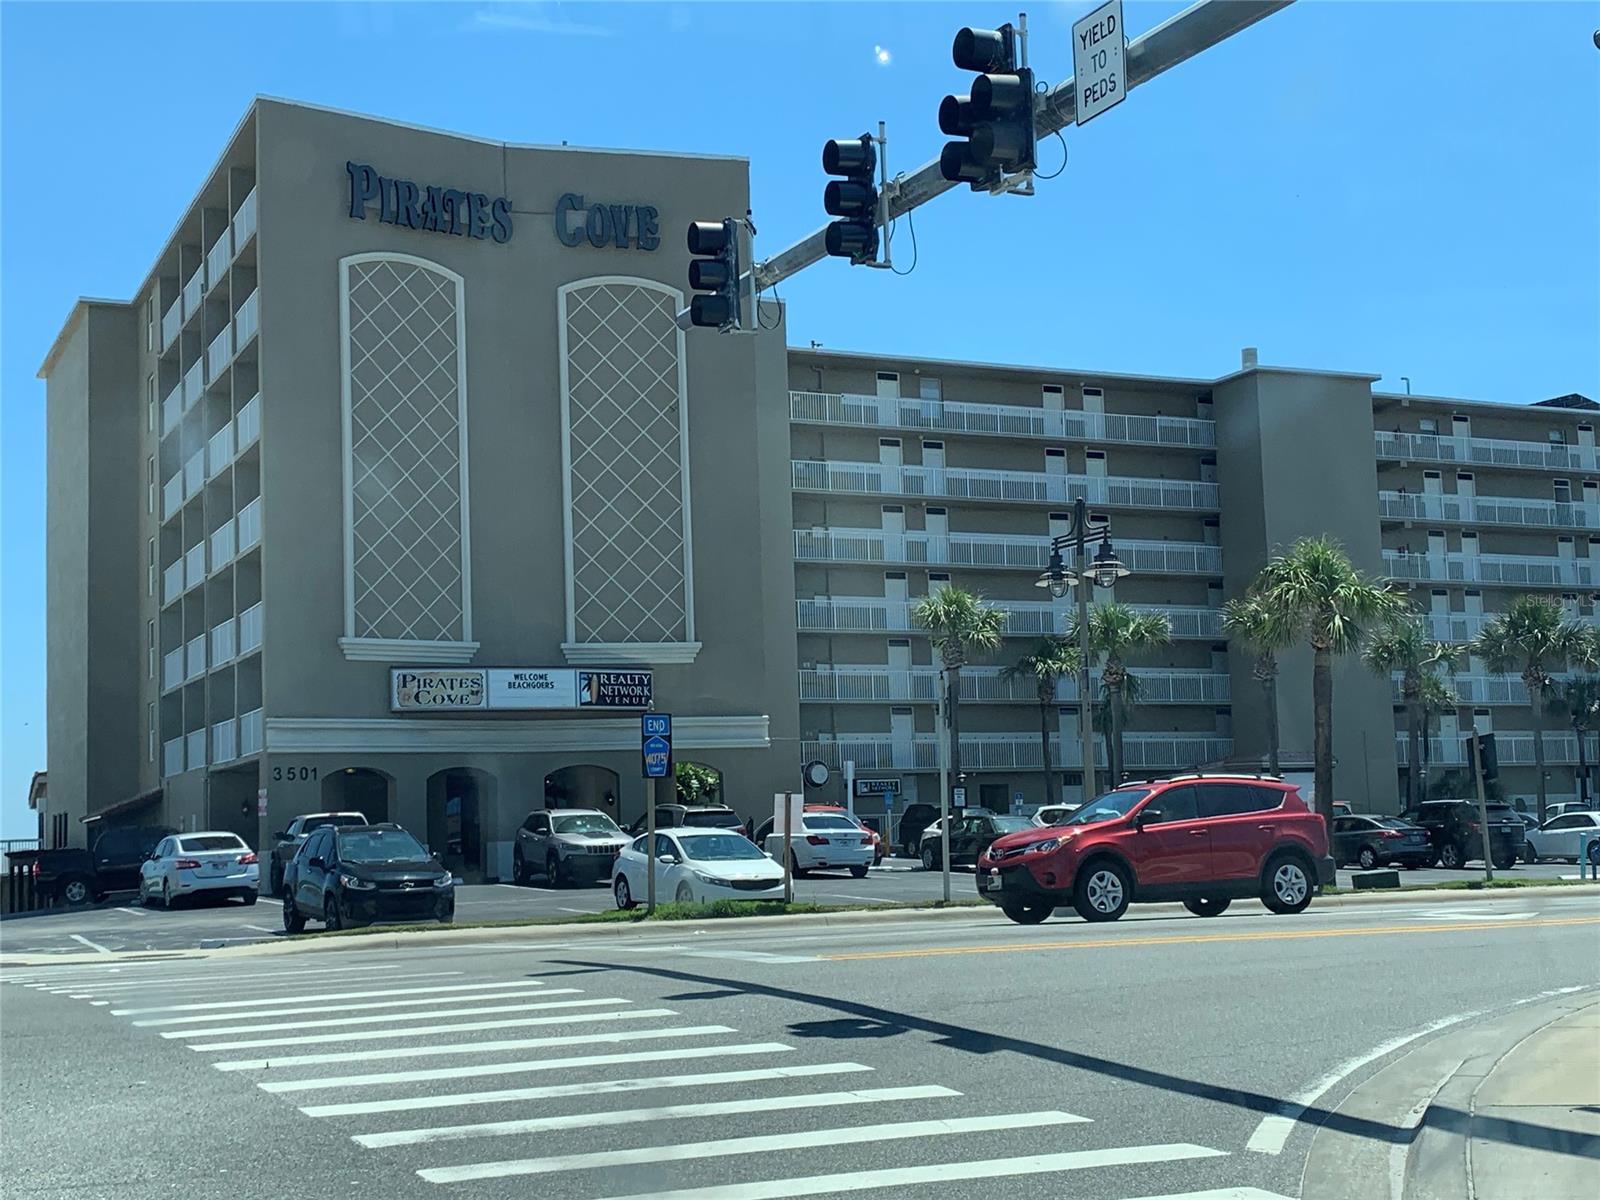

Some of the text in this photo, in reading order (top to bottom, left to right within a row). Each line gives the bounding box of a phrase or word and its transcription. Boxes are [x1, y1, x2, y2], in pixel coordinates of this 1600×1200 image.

[1080, 14, 1116, 51] YIELD
[1091, 49, 1107, 73] TO
[1084, 72, 1117, 108] PEDS
[346, 160, 661, 251] PIRATES COVE
[401, 673, 480, 691] PIRATES
[513, 673, 549, 681] WELCOME
[600, 673, 650, 685] REALTY
[507, 681, 555, 689] BEACHGOERS
[600, 685, 651, 696] NETWORK
[413, 689, 470, 705] COVE
[605, 696, 648, 705] VENUE
[648, 719, 665, 732] END
[273, 766, 318, 781] 3501
